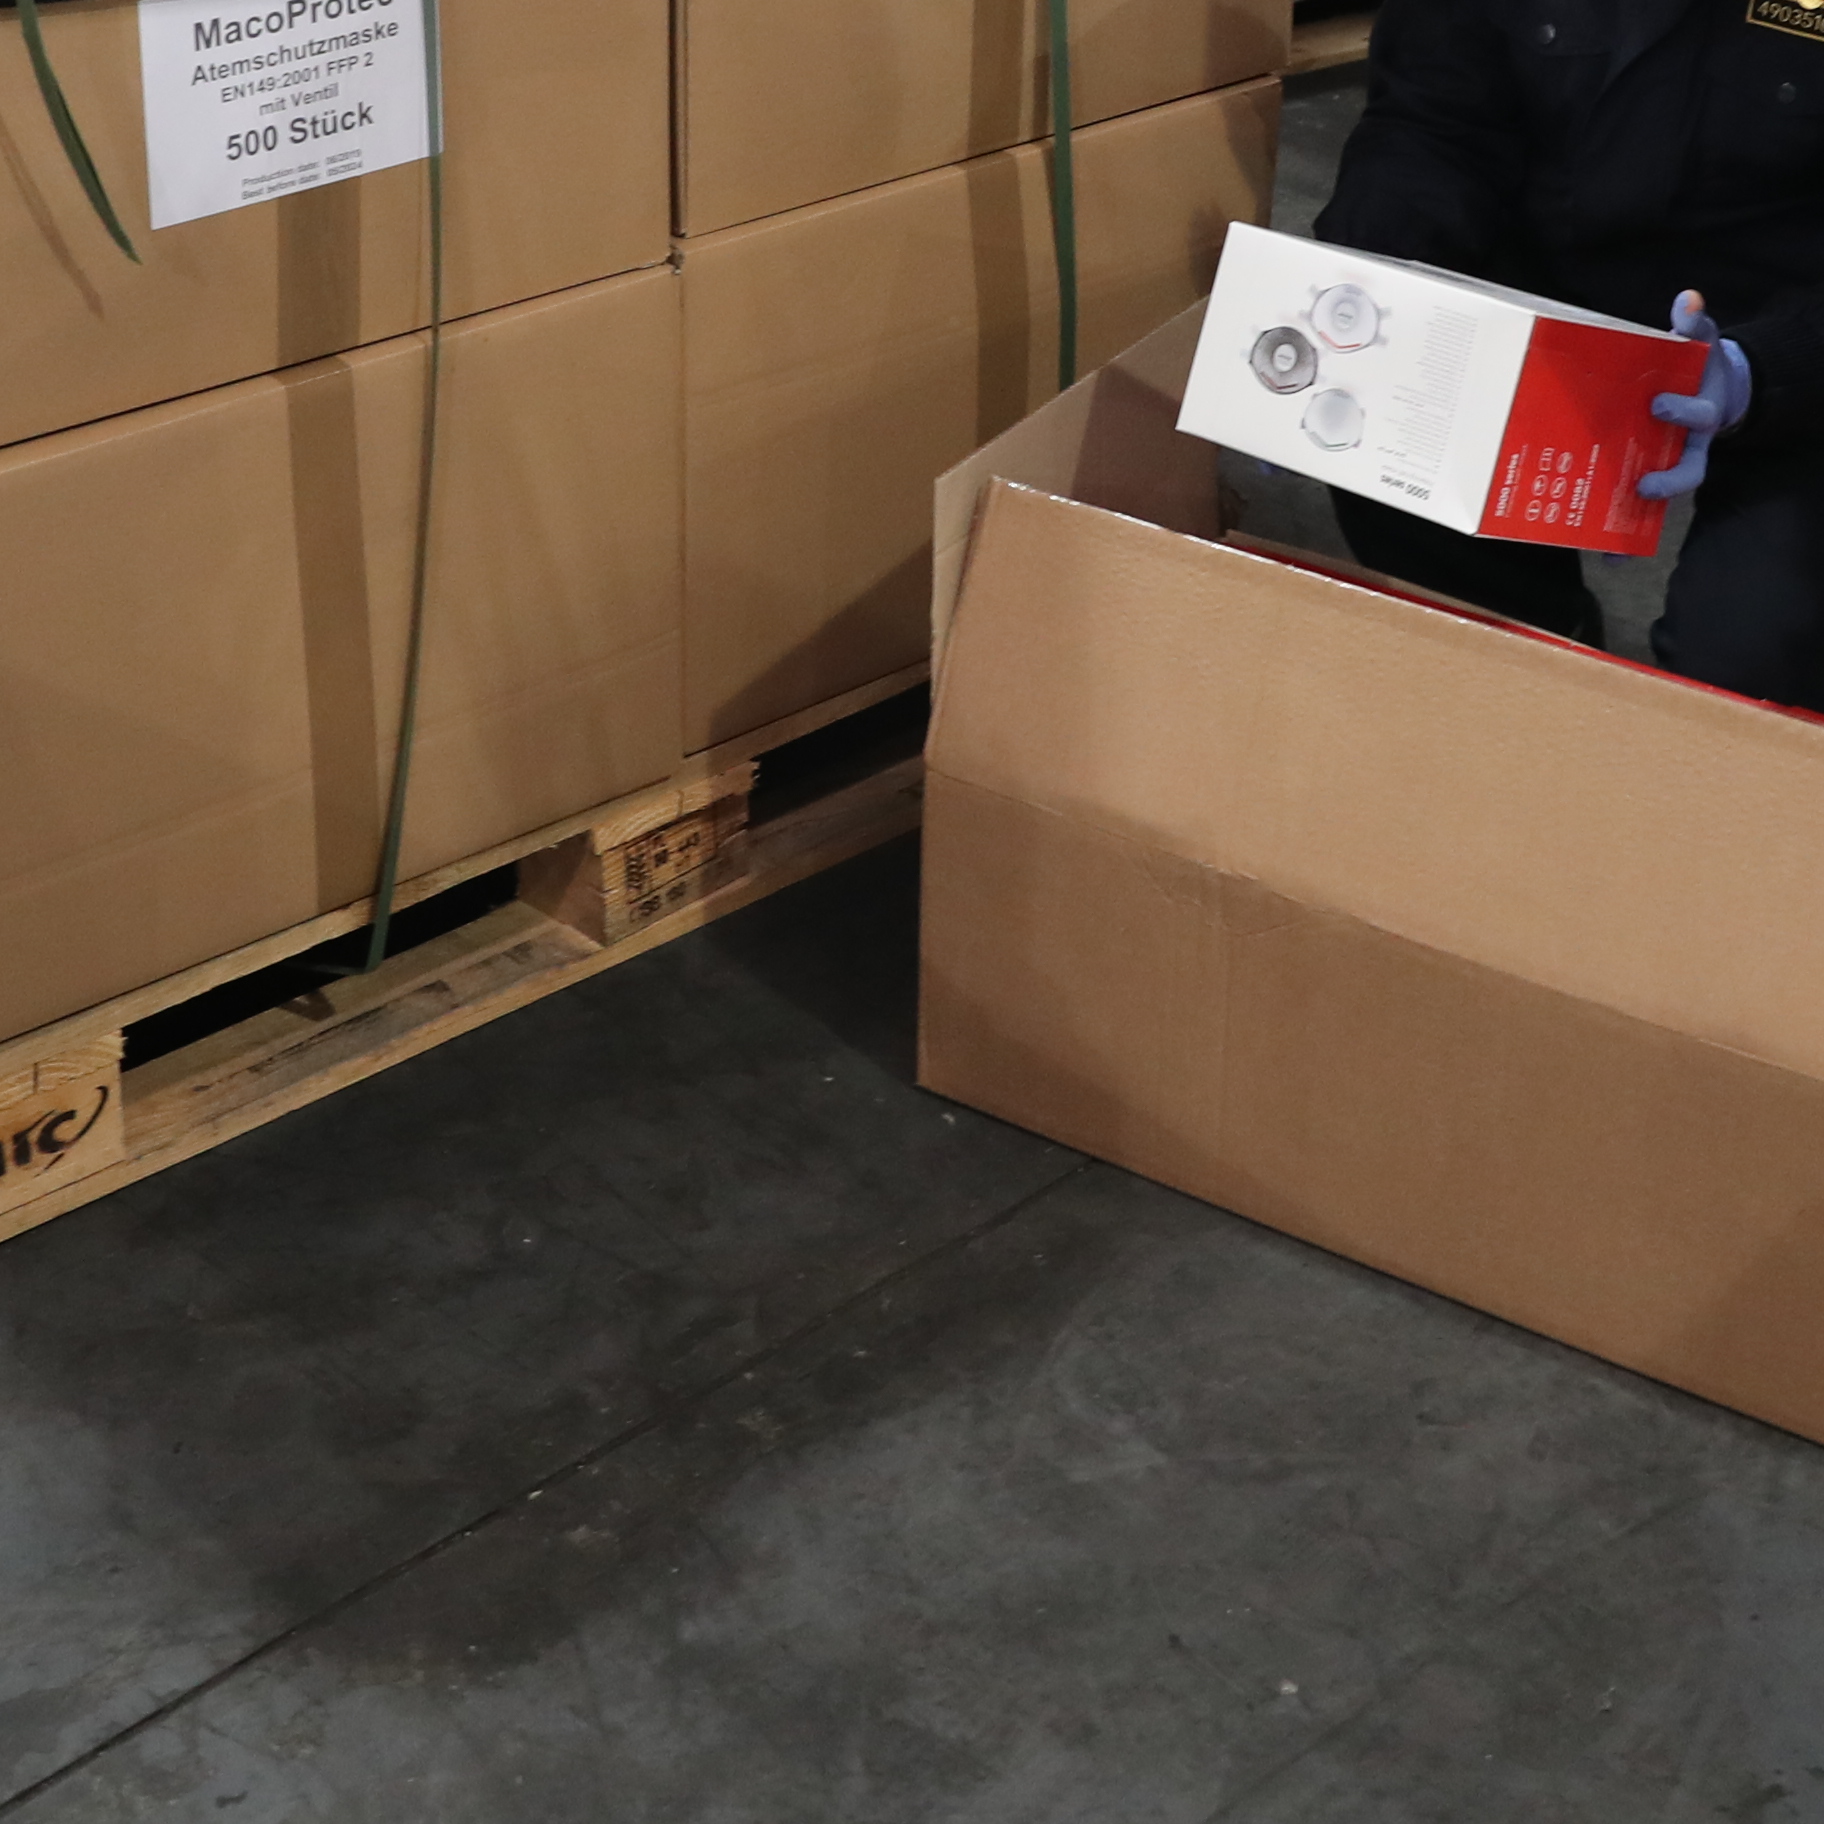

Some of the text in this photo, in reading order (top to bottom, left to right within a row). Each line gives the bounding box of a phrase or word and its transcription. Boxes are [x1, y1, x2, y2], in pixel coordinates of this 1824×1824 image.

[191, 21, 400, 86] Atemschutzmaske
[221, 51, 375, 103] EN149:2001 FFP 2
[259, 82, 339, 116] mit Ventil
[226, 102, 375, 161] 500 Stück
